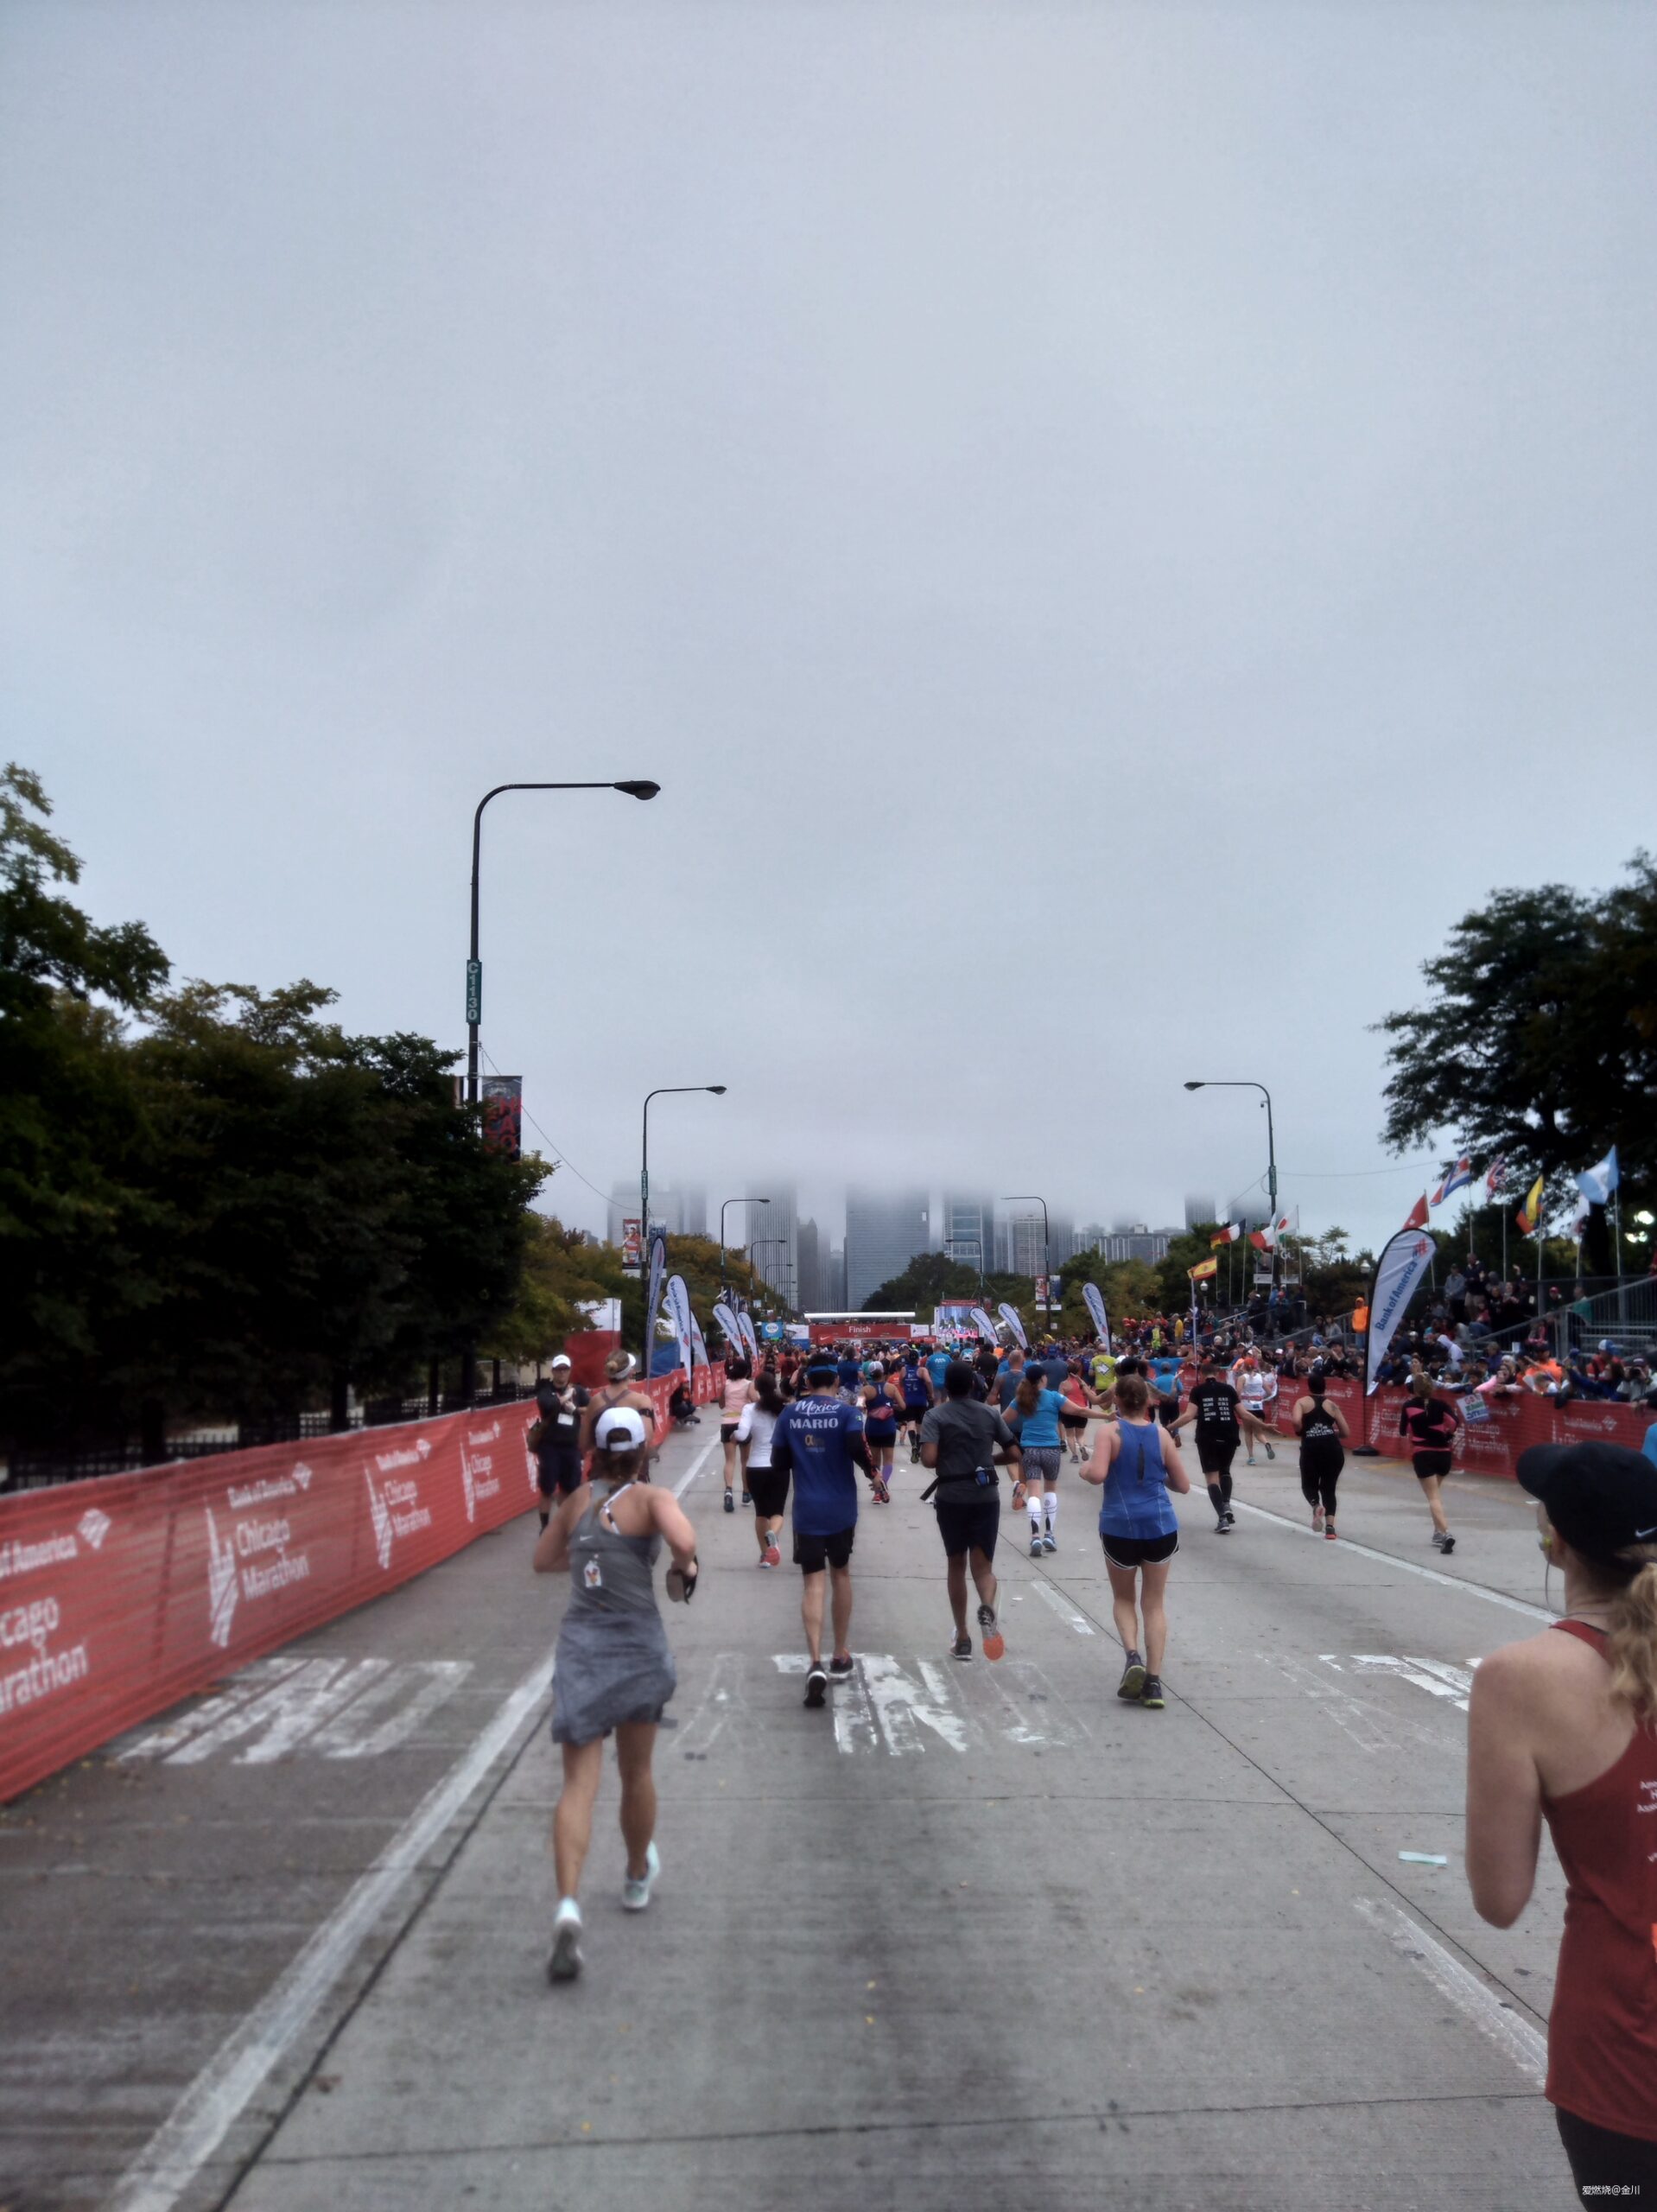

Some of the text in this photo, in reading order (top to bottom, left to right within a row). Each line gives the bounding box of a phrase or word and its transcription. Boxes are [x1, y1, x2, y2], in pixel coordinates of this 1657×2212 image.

[1374, 1306, 1393, 1331] Bank
[1391, 1261, 1419, 1299] America
[790, 1418, 839, 1429] MARIO
[12, 1532, 78, 1575] America
[236, 1518, 291, 1557] Chicago
[241, 1554, 310, 1604] Marathon
